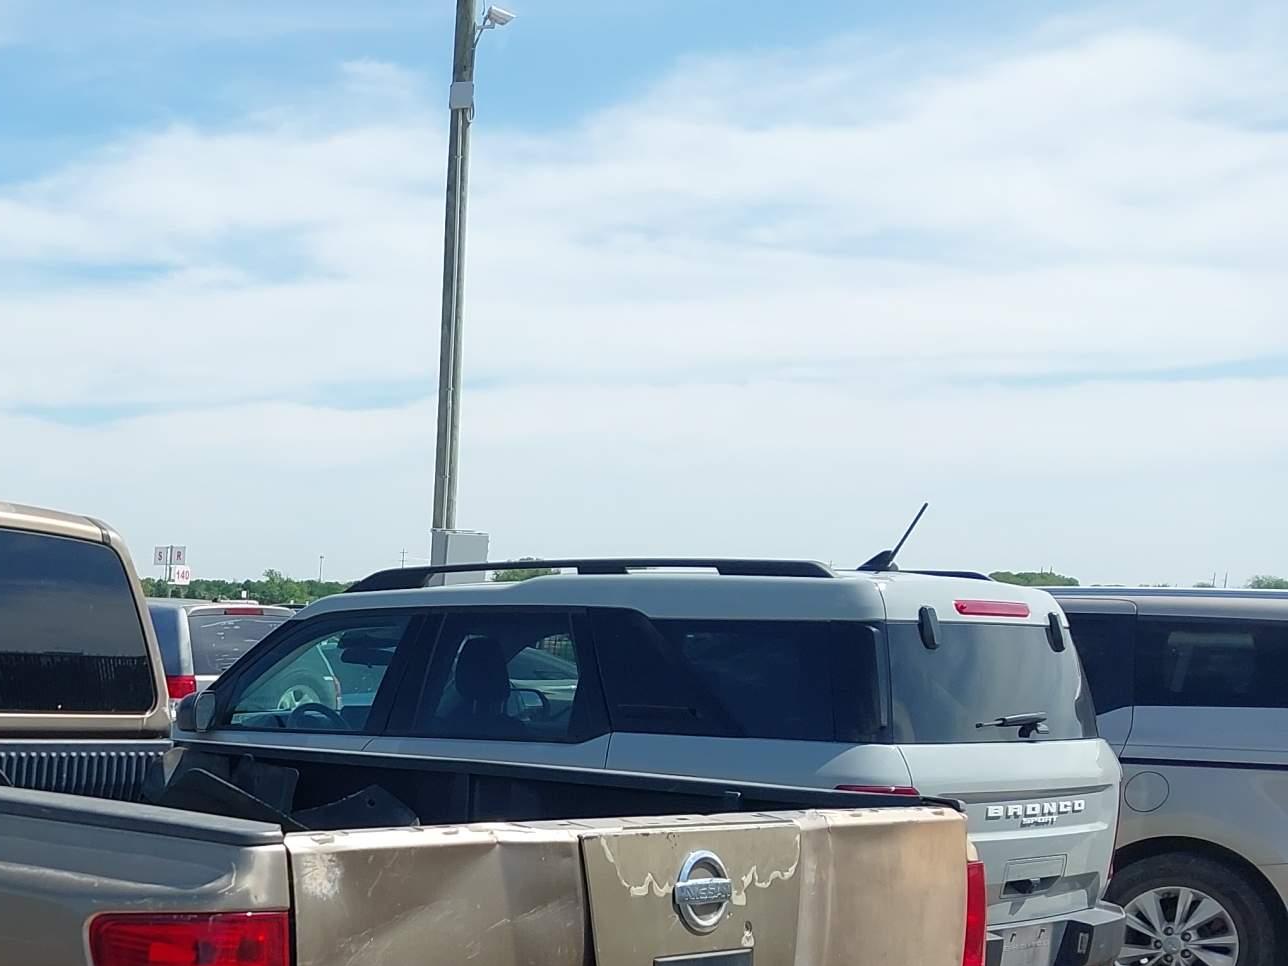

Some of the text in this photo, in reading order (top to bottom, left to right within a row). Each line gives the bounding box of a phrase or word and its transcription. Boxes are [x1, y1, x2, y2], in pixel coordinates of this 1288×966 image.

[176, 569, 190, 580] 140
[986, 799, 1086, 819] BRONCO
[1021, 815, 1058, 826] SPORT
[684, 883, 731, 900] NISSAN
